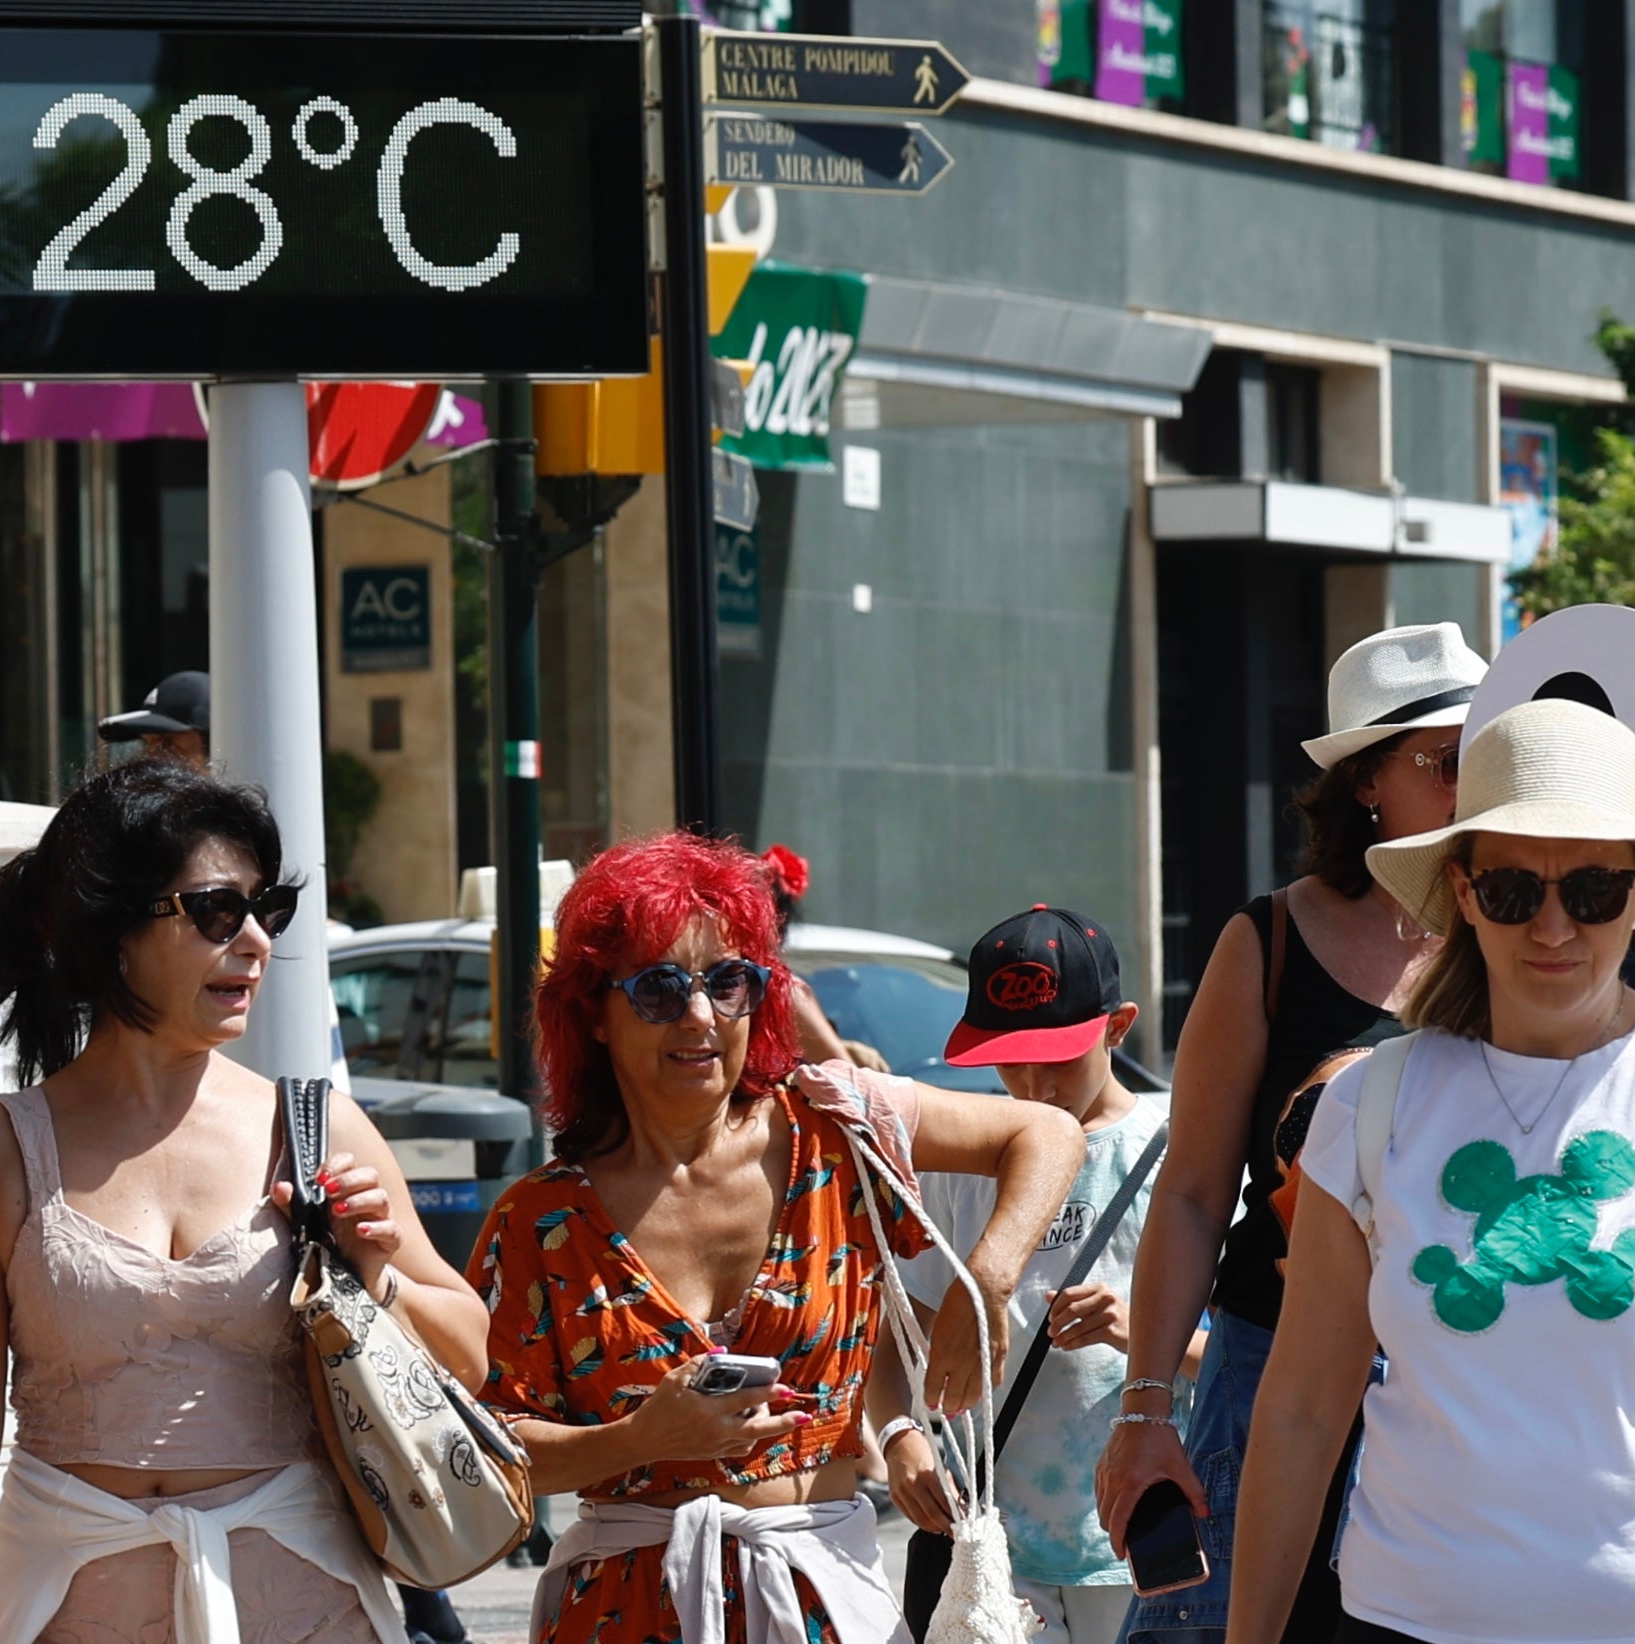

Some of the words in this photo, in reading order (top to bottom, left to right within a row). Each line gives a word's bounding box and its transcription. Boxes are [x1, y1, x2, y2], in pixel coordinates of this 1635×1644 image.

[720, 43, 797, 71] CENTRE
[804, 47, 896, 77] POMPIDOU
[722, 66, 799, 99] MÁLAGA
[723, 121, 797, 147] SENDERO
[725, 151, 764, 180] DEL
[774, 153, 866, 186] MIRADOR
[32, 92, 520, 292] 28°C
[351, 578, 422, 620] AC
